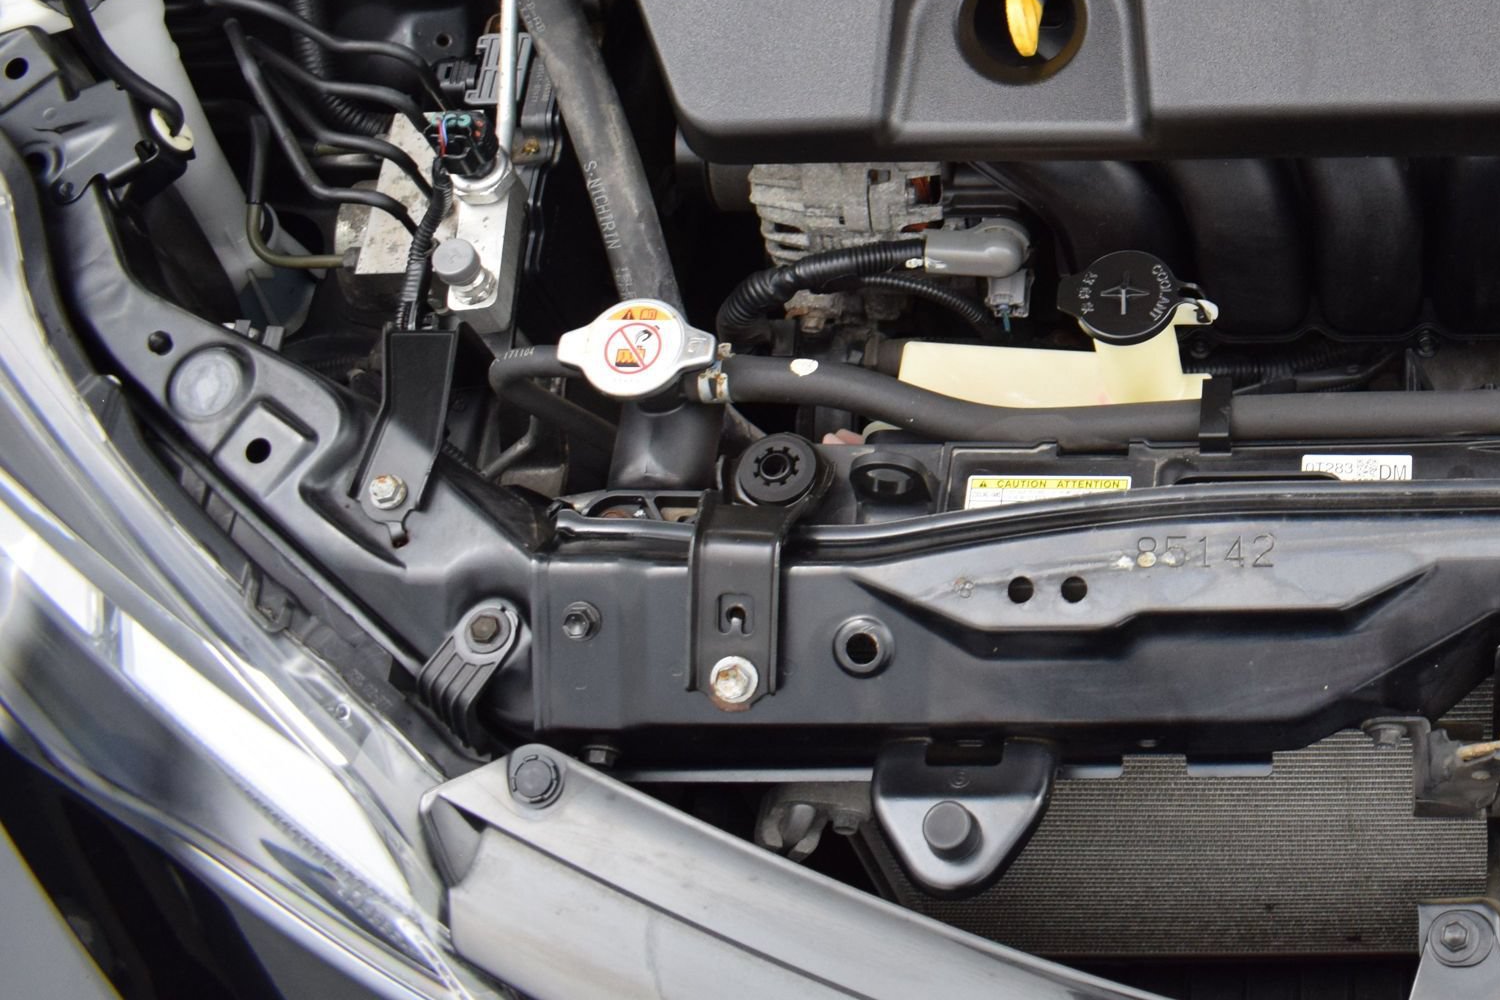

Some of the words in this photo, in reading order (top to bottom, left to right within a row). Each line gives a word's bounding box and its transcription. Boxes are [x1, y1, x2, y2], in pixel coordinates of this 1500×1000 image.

[1149, 264, 1172, 321] COOLANT
[996, 480, 1047, 488] CAUTION
[1057, 480, 1120, 488] ATTENTION
[1379, 464, 1407, 480] DM
[1136, 532, 1276, 568] 85142
